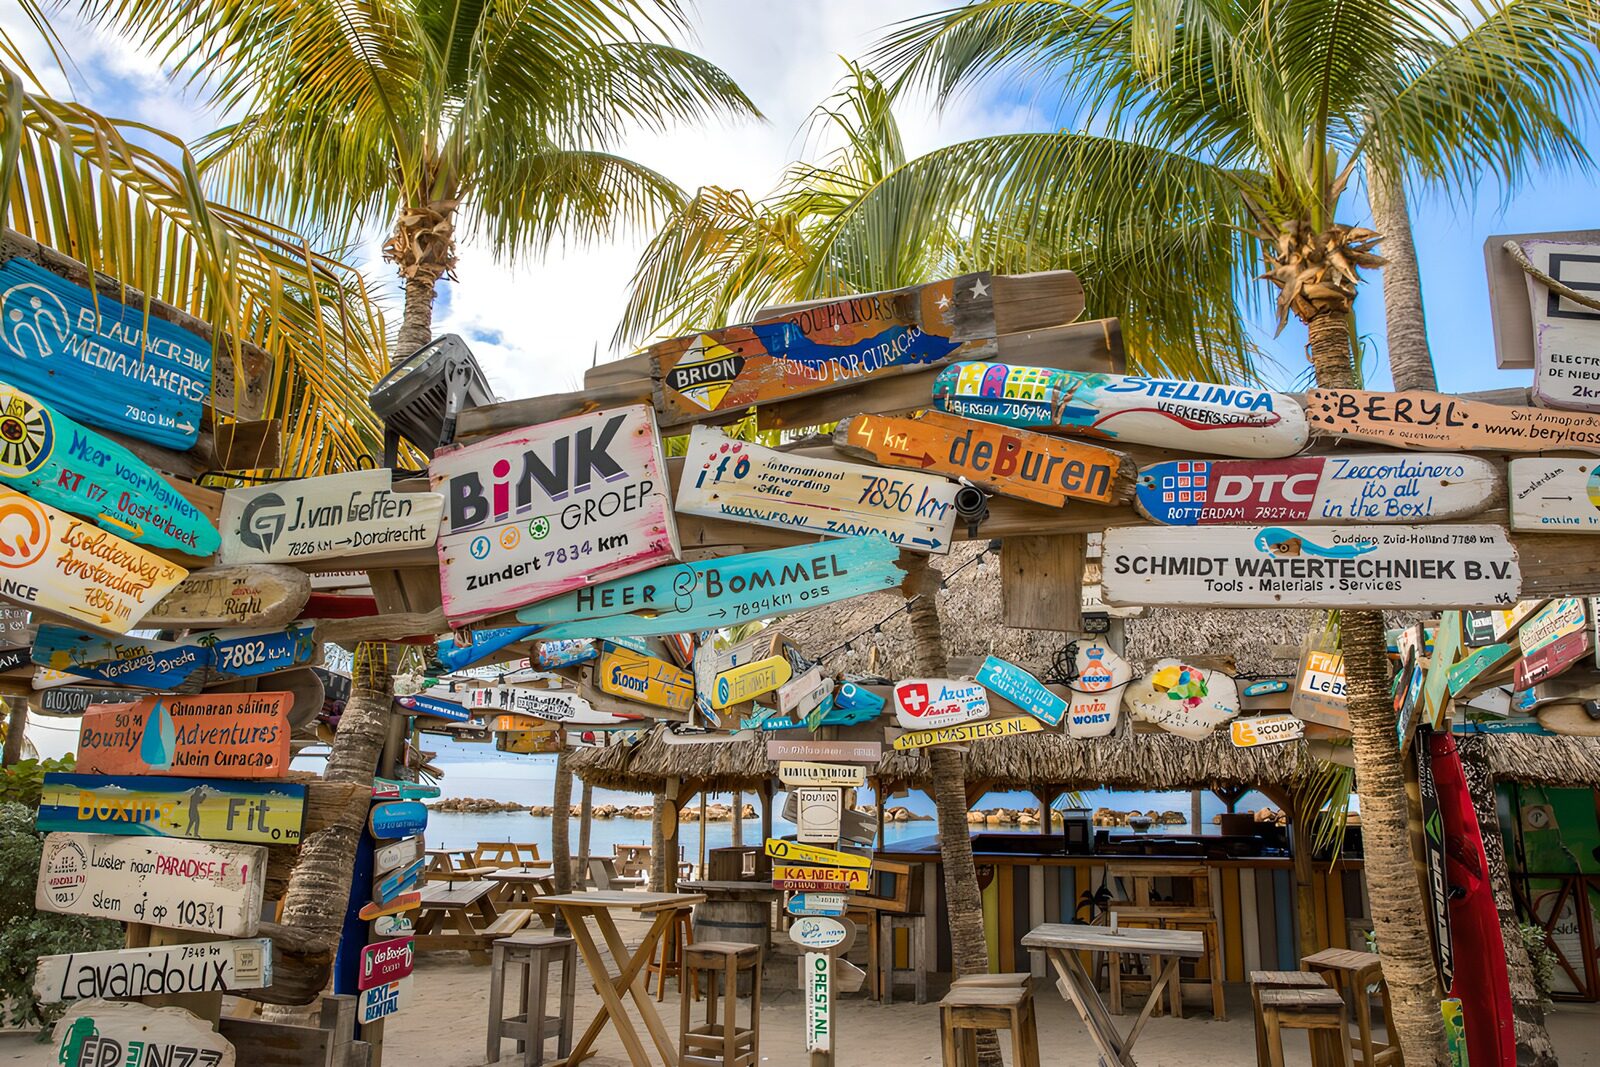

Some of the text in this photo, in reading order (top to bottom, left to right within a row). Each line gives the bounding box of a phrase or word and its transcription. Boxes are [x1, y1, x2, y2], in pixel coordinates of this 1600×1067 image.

[829, 353, 864, 382] FOR
[862, 325, 922, 374] CURAÇAO
[63, 334, 205, 402] MEDIAMAKERS
[675, 357, 738, 389] BRION
[1549, 369, 1564, 378] DE
[1103, 376, 1273, 413] STELLINGA
[1337, 393, 1464, 428] BERYL
[1511, 410, 1532, 422] Sint
[858, 417, 874, 447] 4
[67, 429, 111, 469] Meer
[949, 429, 1112, 496] deBuren
[57, 468, 86, 493] RT
[115, 461, 147, 488] voor
[1331, 459, 1464, 480] Zeecontainers
[857, 474, 913, 514] 7856
[1214, 473, 1319, 504] DTC
[1362, 478, 1420, 500] its all
[346, 490, 413, 523] Geffen
[560, 480, 655, 530] GROEP
[1167, 507, 1245, 520] ROTTERDAM
[1255, 507, 1288, 520] 7827
[1322, 498, 1433, 518] in the Box!
[117, 491, 202, 549] Oosterbeek
[1541, 516, 1581, 525] online
[353, 524, 427, 548] Dordrecht
[1383, 533, 1450, 545] Zuid-Holland
[56, 548, 146, 603] Amsterdam
[466, 556, 542, 591] Zundert
[544, 540, 594, 568] 7834
[597, 532, 629, 552] km
[1114, 555, 1513, 581] SCHMIDT WATERTECHNIEK B.V.
[577, 554, 848, 613] HEER BOMMEL
[1205, 578, 1403, 593] Tools Materials Services
[84, 587, 114, 613] 7856
[224, 597, 262, 621] Right
[732, 600, 771, 619] 7894
[156, 650, 196, 674] Breda
[220, 641, 266, 669] 7882
[236, 699, 280, 717] sailing
[81, 723, 280, 754] Bounty Adventures
[902, 718, 1028, 748] MUD MASTERS NL
[77, 790, 176, 829] Boxing
[226, 797, 270, 833] Fit
[91, 844, 126, 871] Luister
[130, 858, 156, 873] naar
[152, 903, 168, 924] op
[60, 953, 229, 1001] Lavandoux
[366, 983, 391, 1007] NEXT
[365, 997, 399, 1022] RENTAL
